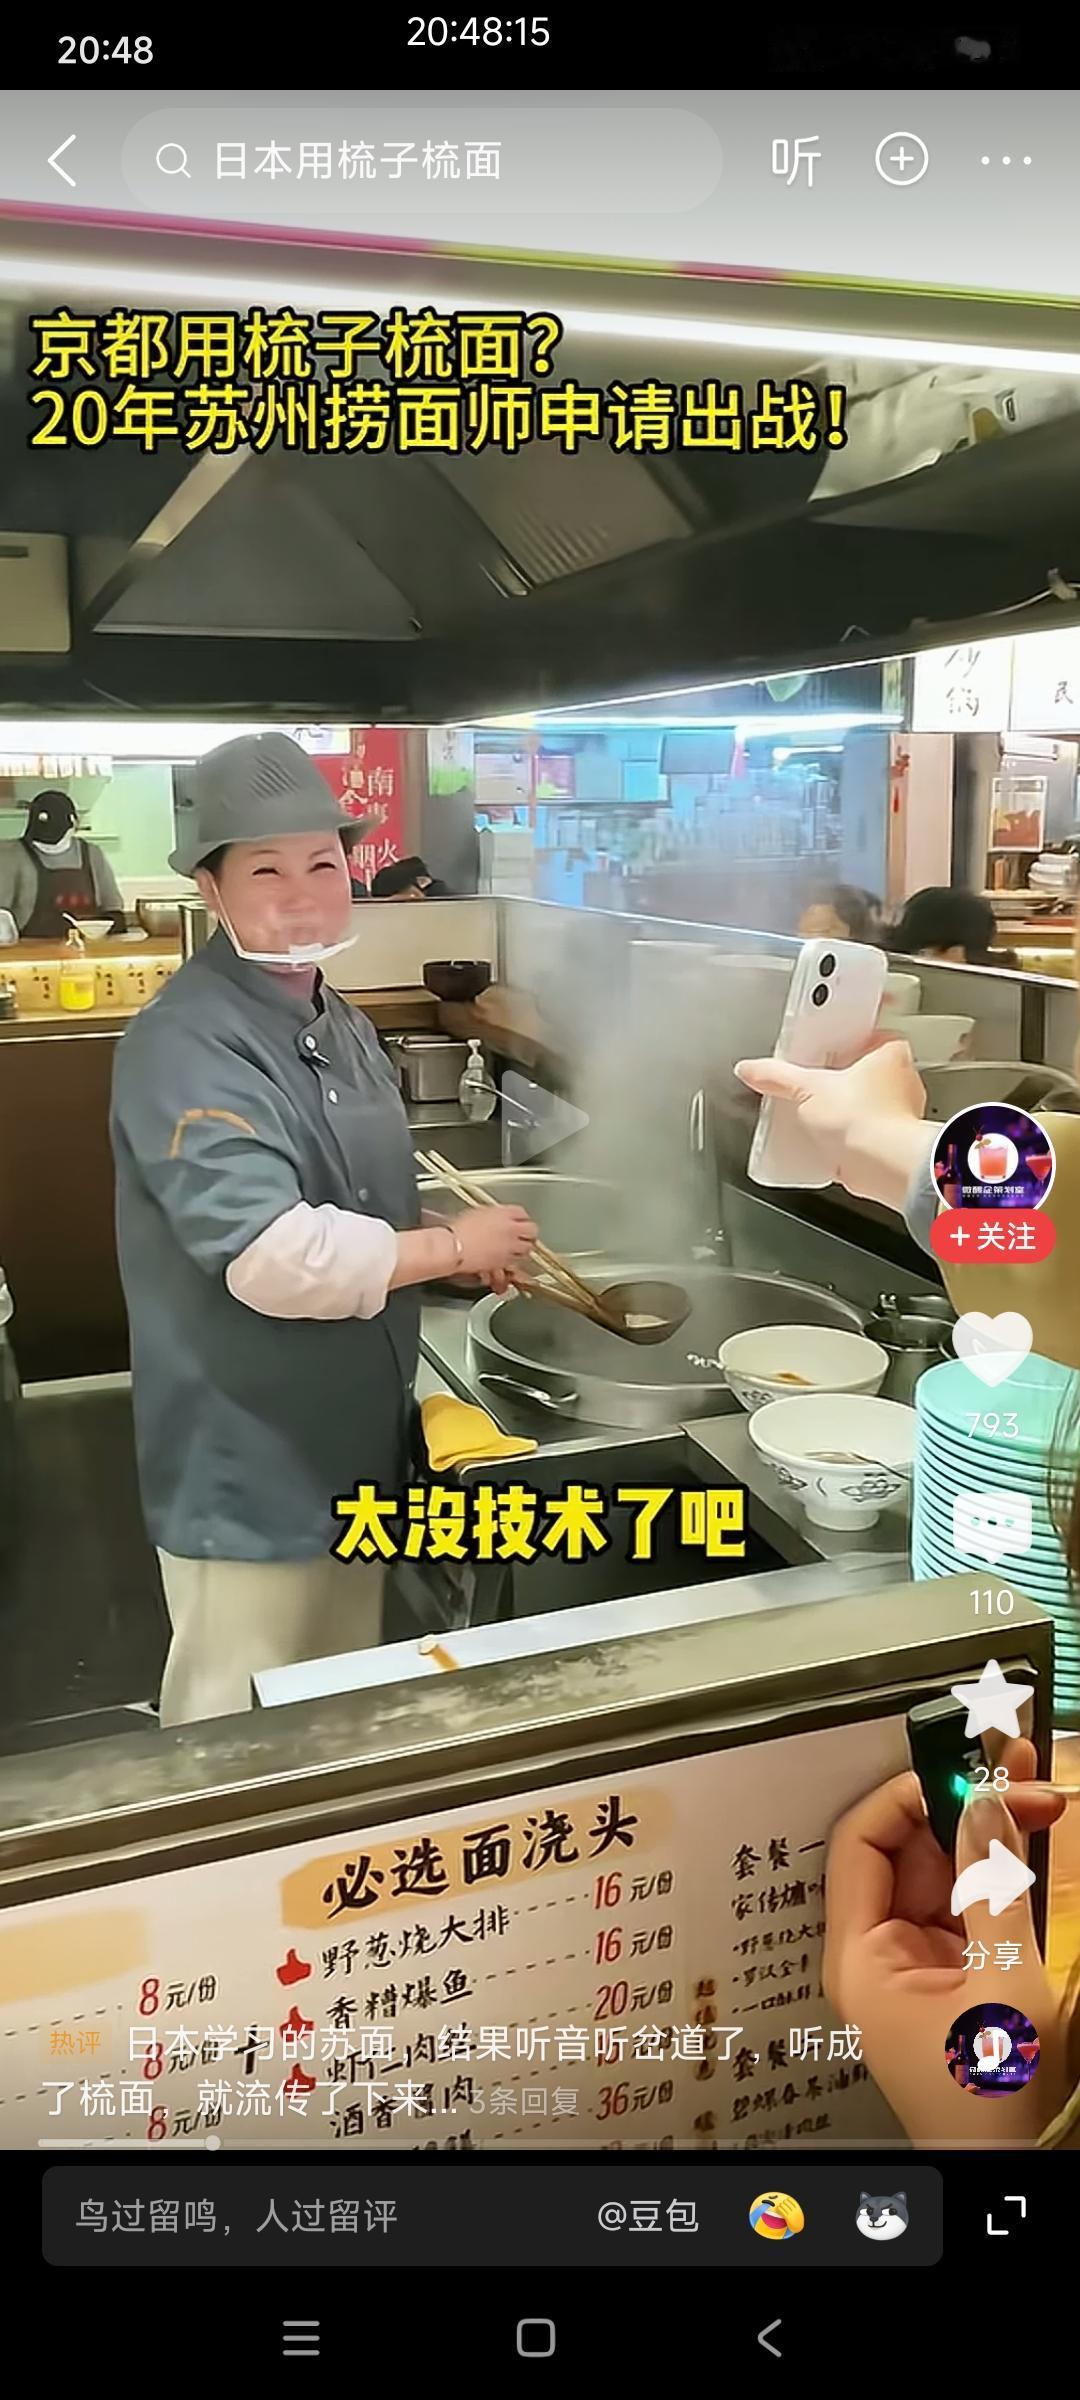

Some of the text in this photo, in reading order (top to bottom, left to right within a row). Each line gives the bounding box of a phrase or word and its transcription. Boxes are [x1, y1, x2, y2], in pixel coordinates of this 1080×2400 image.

[322, 1796, 639, 1919] 必选面浇头
[321, 1904, 512, 1980] 野葱烧大排
[326, 1968, 474, 2031] 香糟爆鱼
